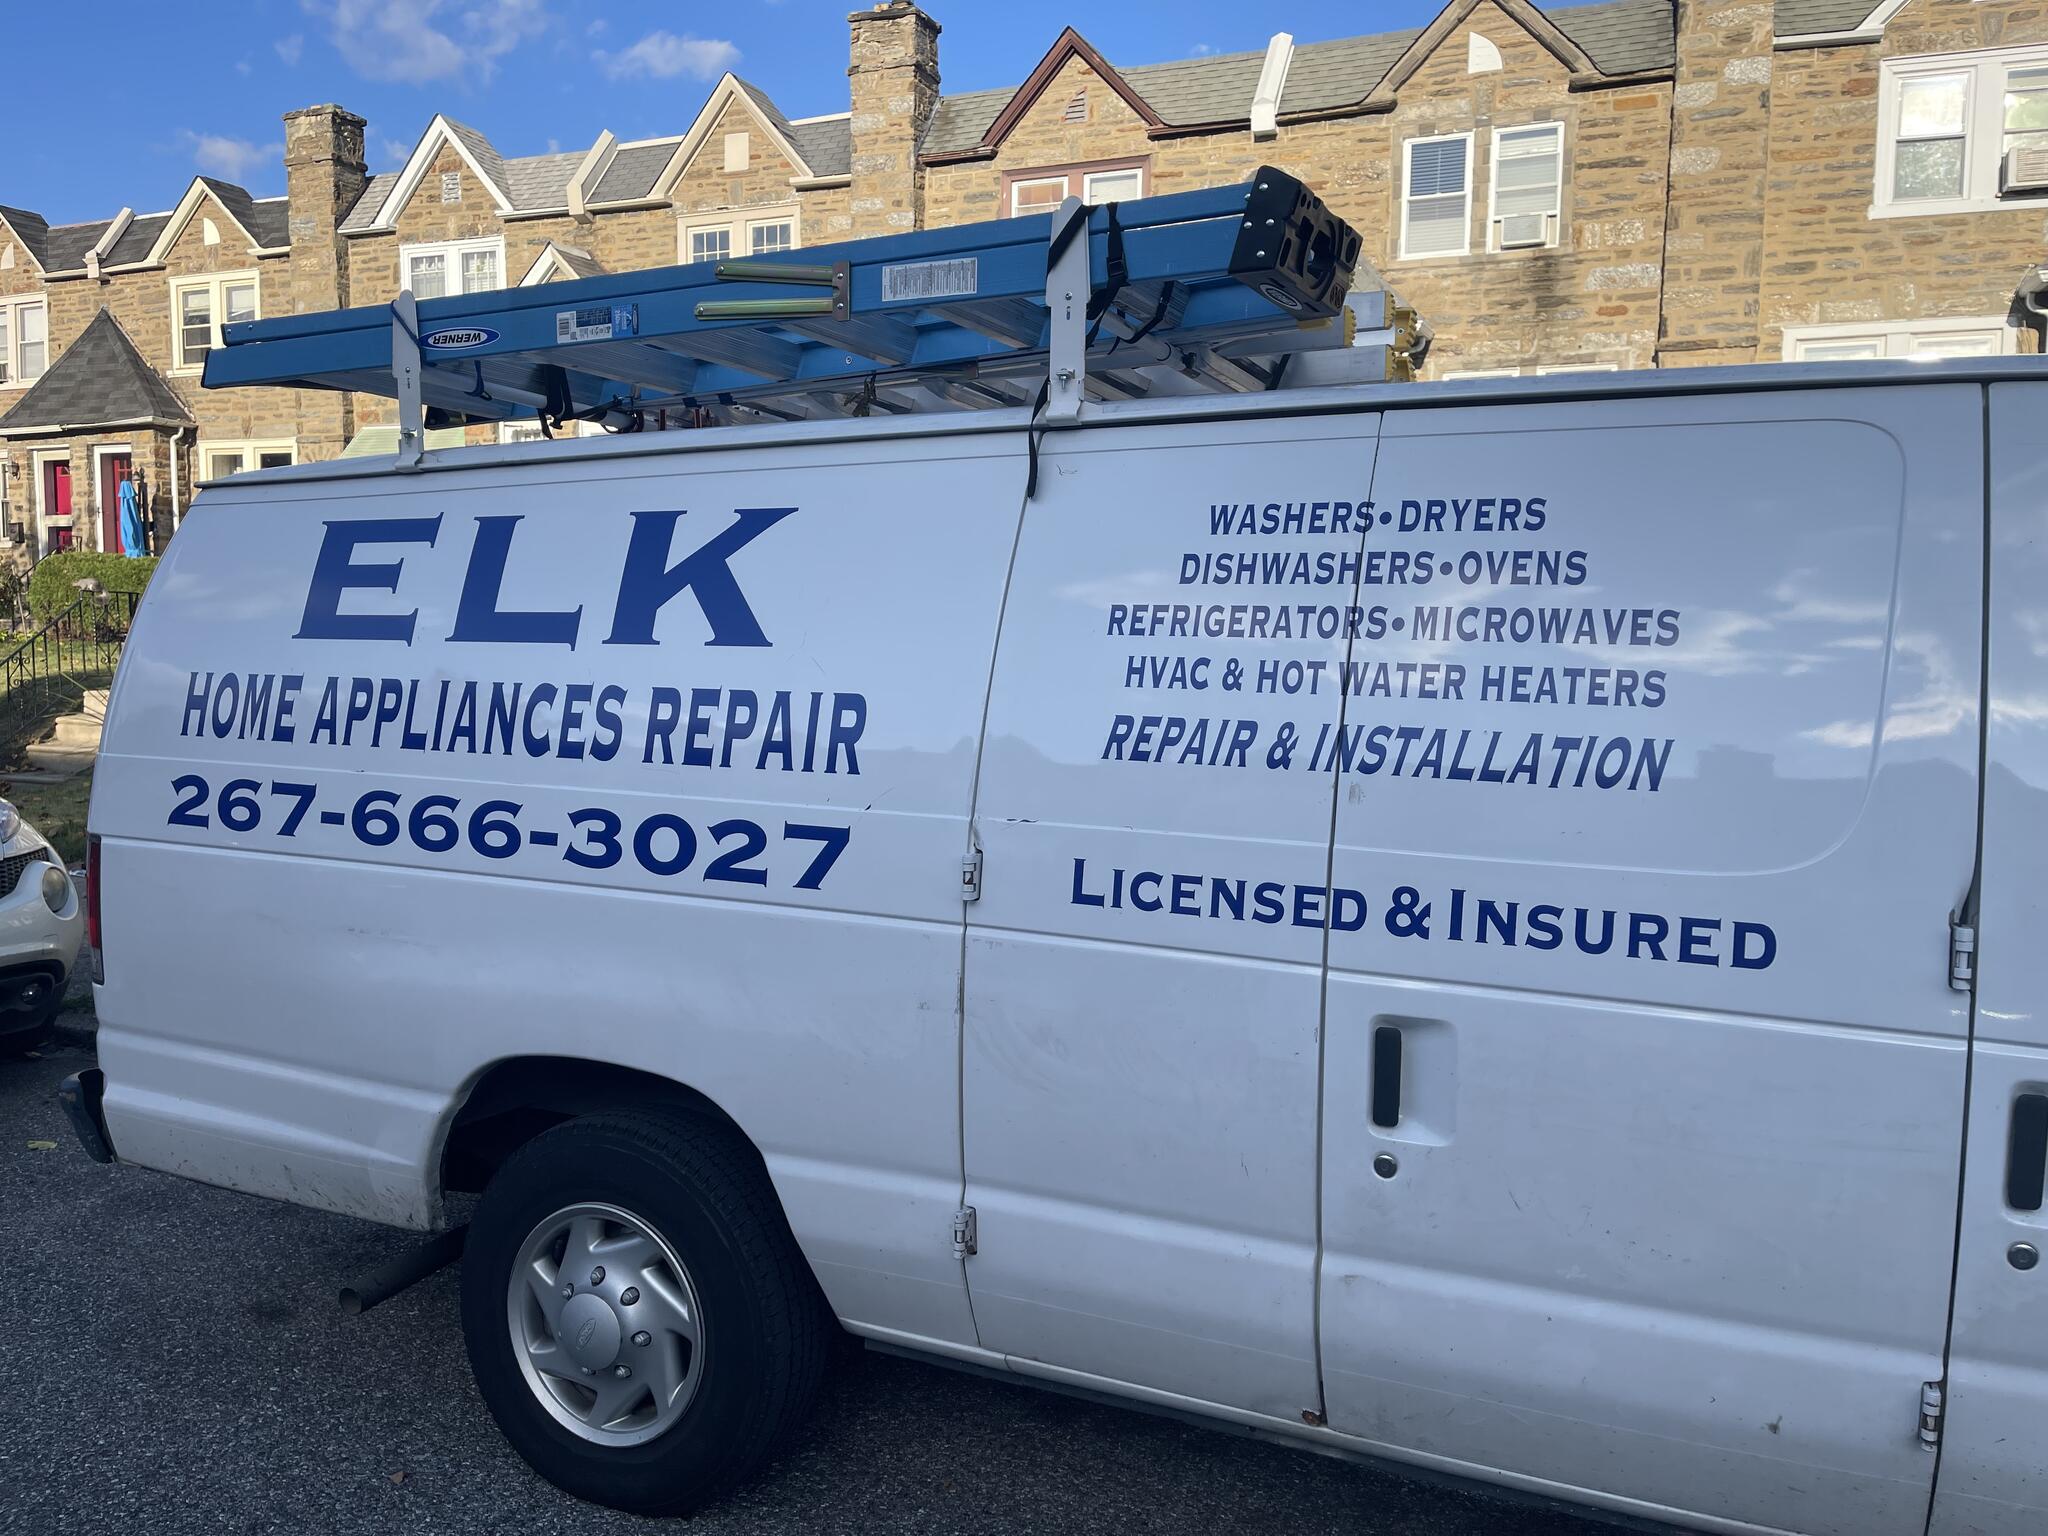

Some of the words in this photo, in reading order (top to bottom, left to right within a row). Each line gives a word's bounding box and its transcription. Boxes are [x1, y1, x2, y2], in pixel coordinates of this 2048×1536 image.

[432, 333, 482, 345] WERNER
[292, 507, 799, 651] ELK
[180, 672, 303, 743] HOME
[310, 677, 628, 761] APPLIANCES
[642, 687, 866, 775] REPAIR
[1125, 656, 1211, 690] HVAC
[1222, 658, 1243, 691] &
[1256, 660, 1326, 694] HOT
[1339, 661, 1467, 701] WATER
[1480, 666, 1666, 707] HEATERS
[1101, 715, 1258, 767] REPAIR
[1266, 722, 1299, 770] &
[1308, 723, 1675, 791] INSTALLATION
[167, 774, 852, 890] 267-666-3027
[1071, 858, 1368, 932] LICENSED
[1385, 886, 1431, 939] &
[1448, 889, 1776, 969] INSURED
